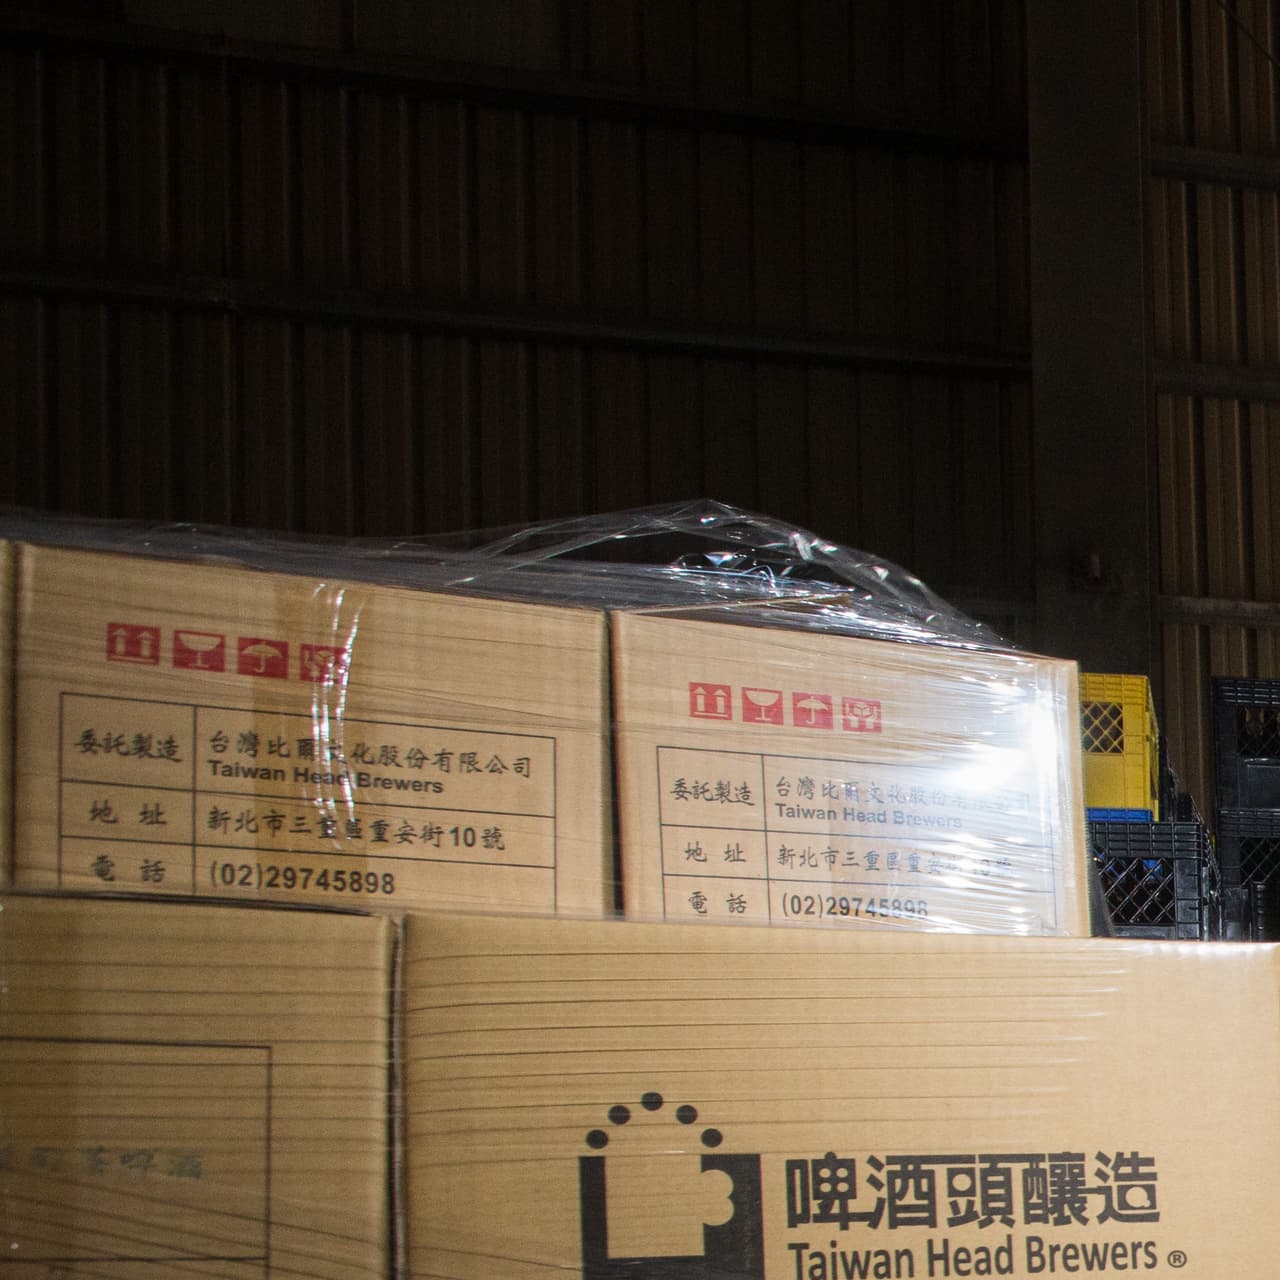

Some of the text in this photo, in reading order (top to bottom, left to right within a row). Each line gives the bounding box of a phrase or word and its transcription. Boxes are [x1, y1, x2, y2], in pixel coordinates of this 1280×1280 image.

[74, 728, 183, 763] 委託製造
[208, 759, 444, 794] Taiwan Head Brewers
[670, 777, 756, 807] 委託製造
[89, 799, 169, 826] 地址
[775, 802, 963, 829] Taiwan Head Brewers
[684, 841, 747, 864] 地址
[91, 853, 166, 883] 電話
[209, 859, 397, 896] (02)29745898
[688, 890, 748, 915] 電話
[785, 1149, 1160, 1231] 啤酒頭釀造
[926, 1235, 1014, 1277] Head
[1026, 1235, 1159, 1274] Brewers
